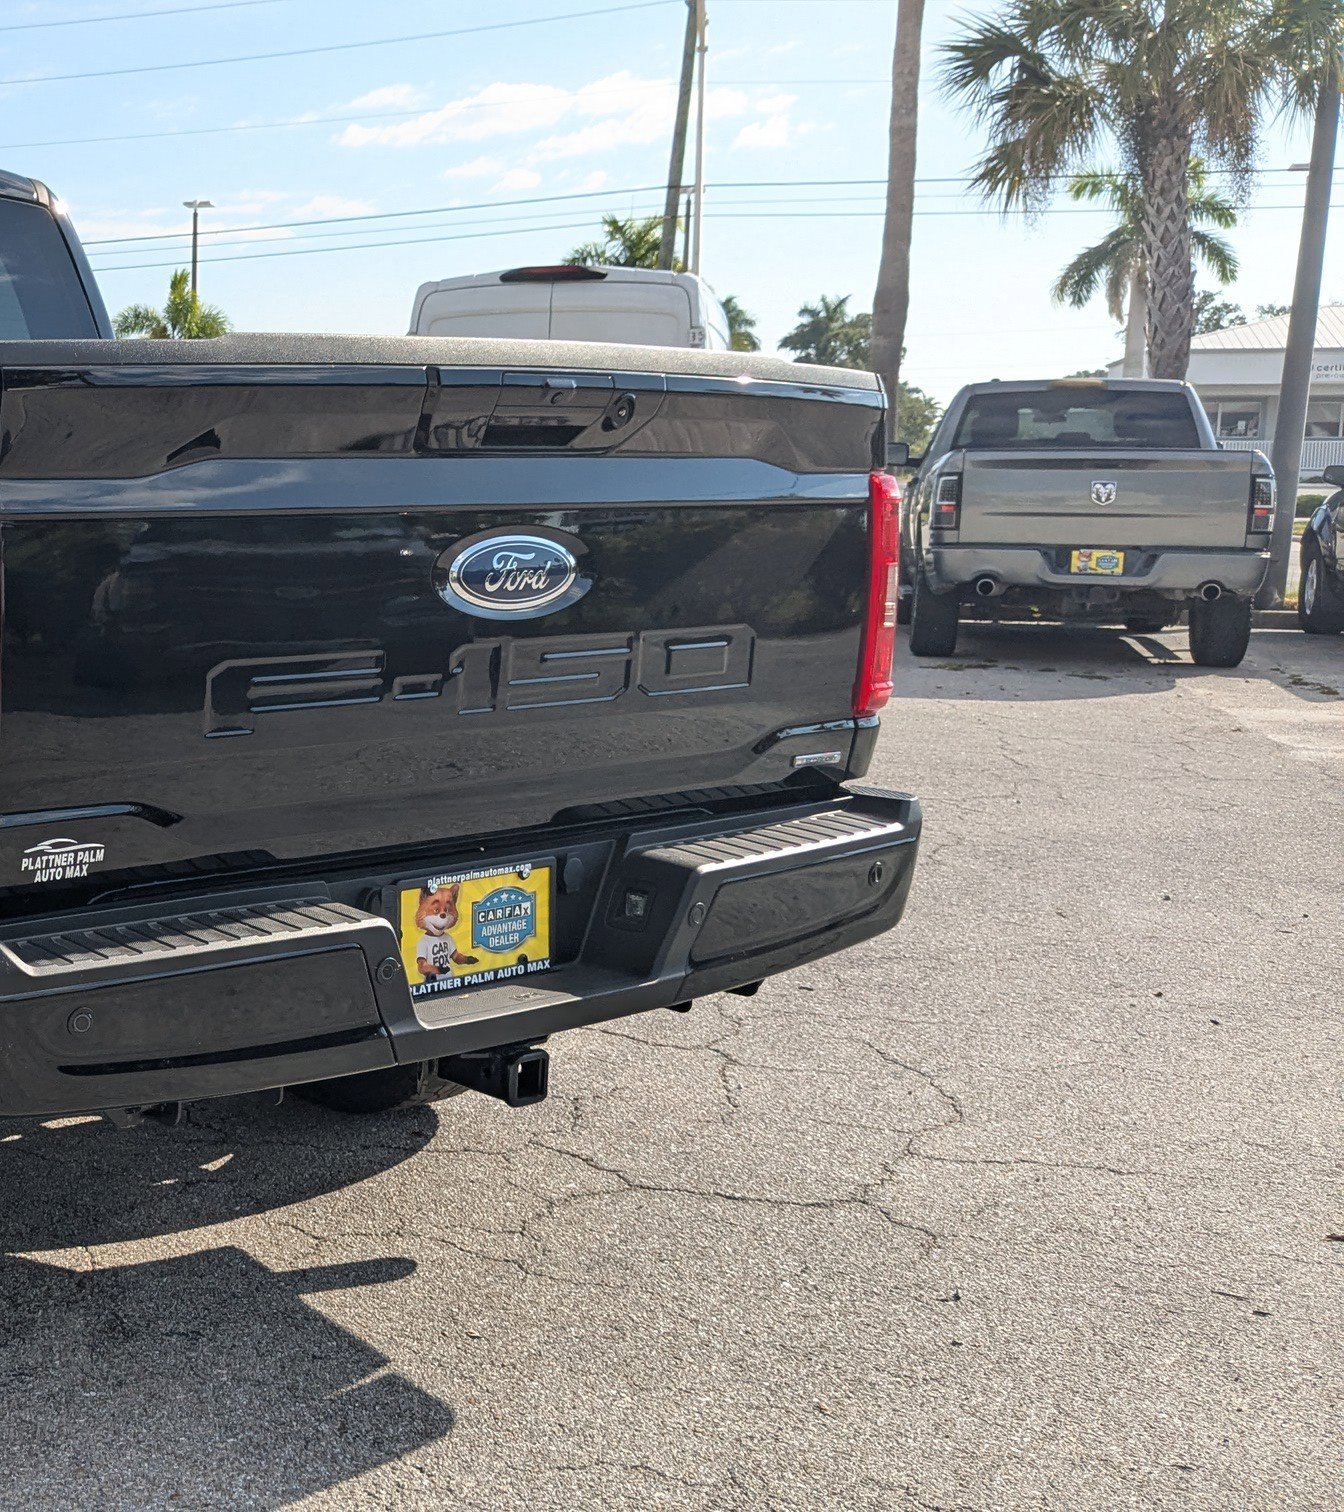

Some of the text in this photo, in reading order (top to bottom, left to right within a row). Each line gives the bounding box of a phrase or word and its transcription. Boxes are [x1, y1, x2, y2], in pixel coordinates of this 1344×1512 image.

[484, 551, 551, 592] Ford
[205, 624, 756, 738] F-150
[21, 849, 105, 871] PLATTNER PALM
[33, 864, 89, 883] AUTO MAX
[478, 903, 530, 923] CARFAX
[481, 920, 527, 936] ADVANTAGE
[432, 942, 448, 955] CAR
[489, 933, 519, 948] DEALER
[433, 953, 450, 966] FOX
[464, 970, 495, 986] PALM
[497, 965, 525, 980] AUTO
[527, 959, 551, 973] MAX
